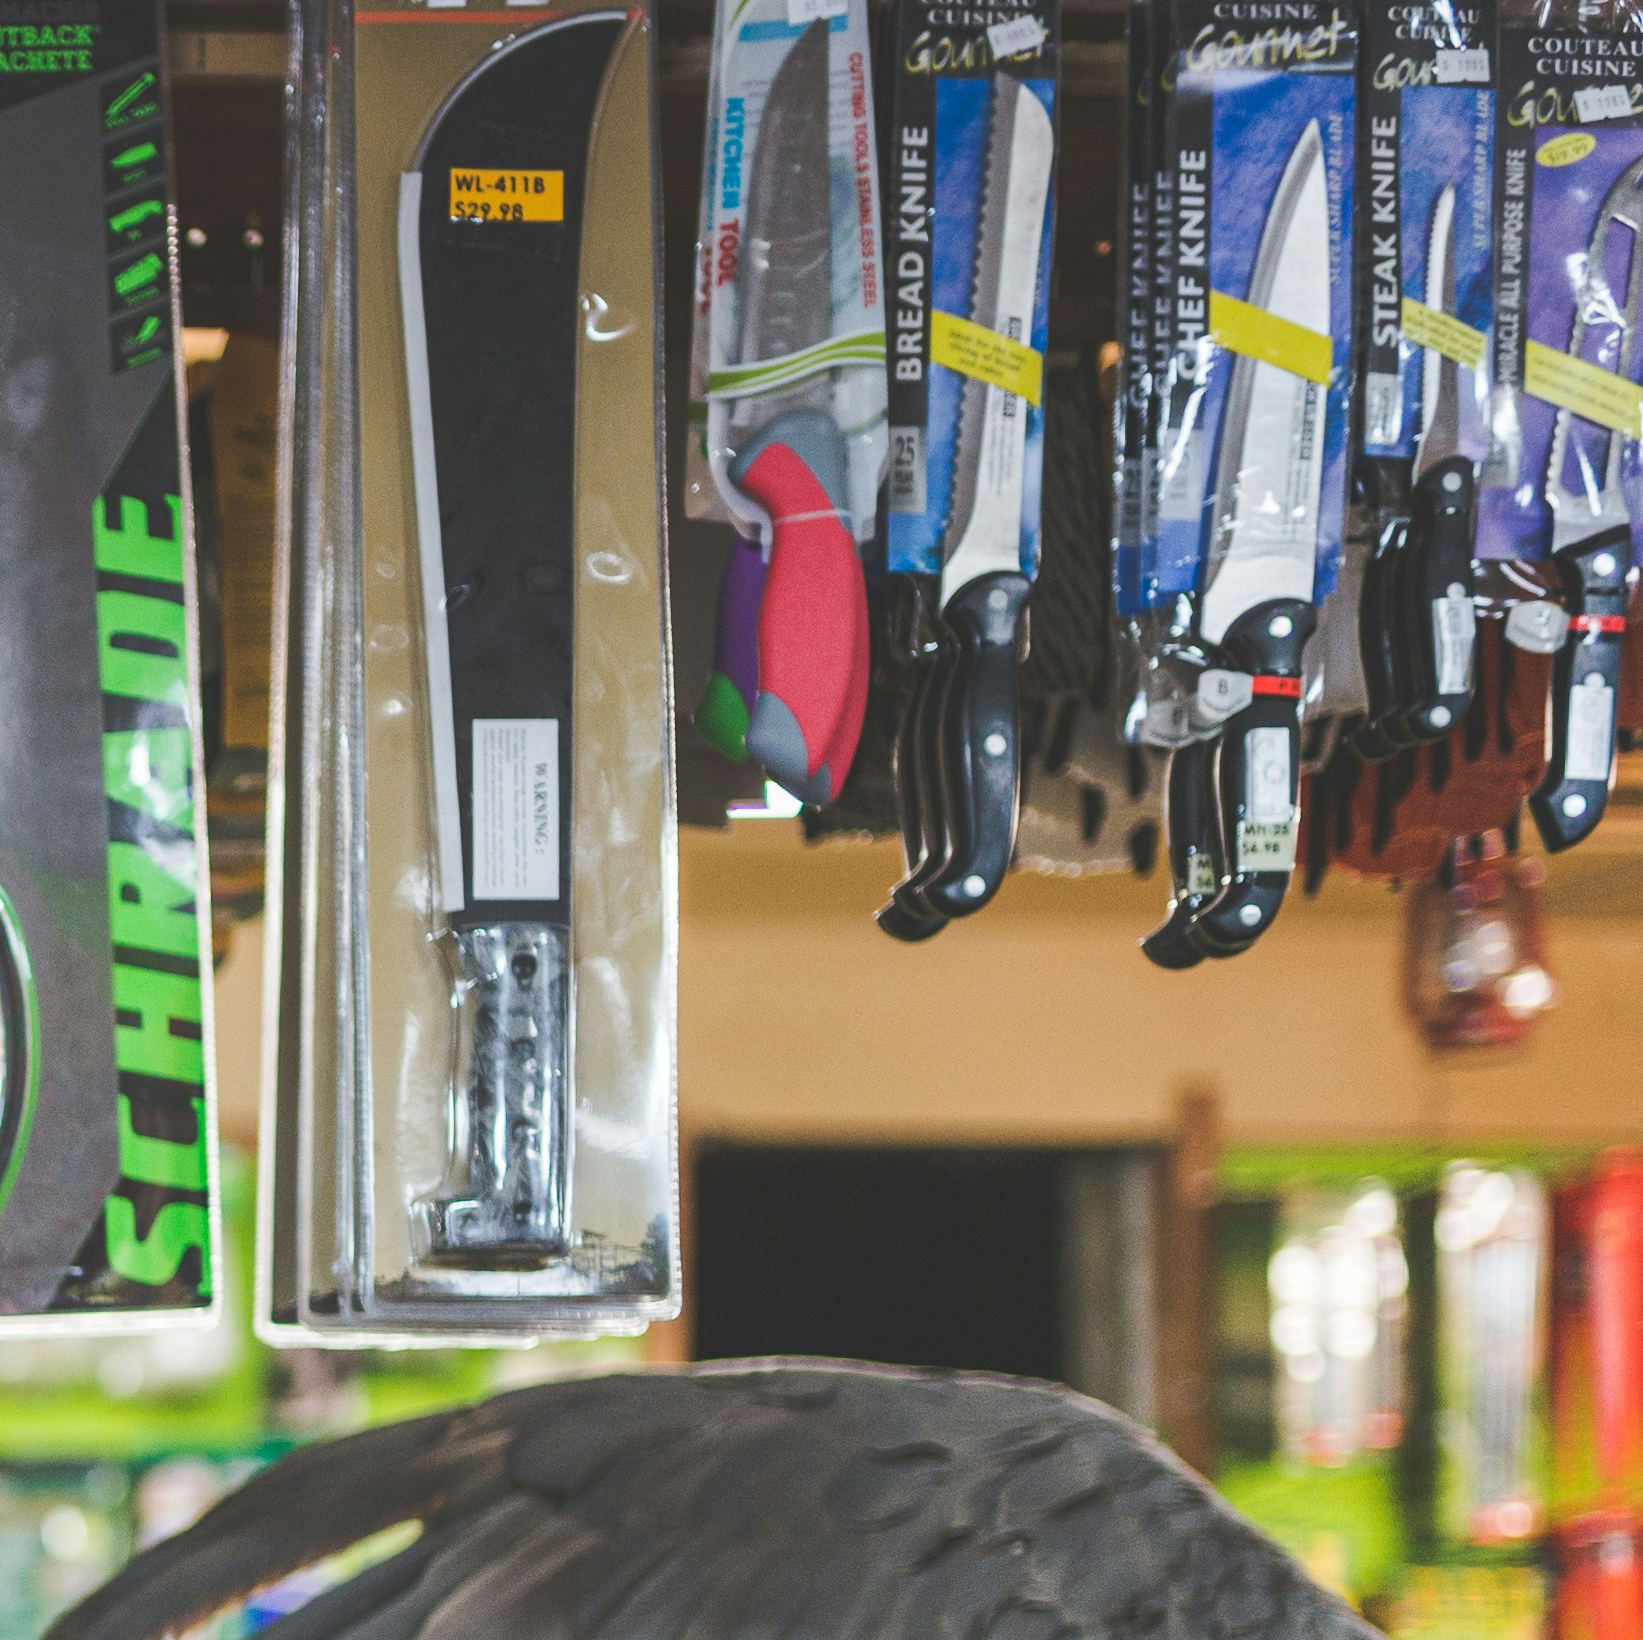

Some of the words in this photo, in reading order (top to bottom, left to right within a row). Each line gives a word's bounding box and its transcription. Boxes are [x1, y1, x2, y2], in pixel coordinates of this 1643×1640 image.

[1215, 4, 1317, 19] CUISINE
[1536, 58, 1636, 76] CUISINE
[455, 175, 545, 194] WL-411B
[721, 98, 746, 210] KITCHEN
[899, 126, 929, 242] KNIFE
[1371, 116, 1397, 223] KNIFE
[1505, 149, 1526, 196] KNIFE
[455, 202, 524, 221] $29.98
[1179, 150, 1207, 266] KNIFE
[1501, 201, 1524, 275] PURPOSE
[715, 219, 740, 287] TOOL
[862, 262, 877, 309] STEEL
[896, 252, 925, 381] BREAD
[1372, 234, 1398, 348] STEAK
[1500, 279, 1520, 308] ALL
[1177, 276, 1206, 381] CHEF
[94, 491, 212, 1299] SCHRADE
